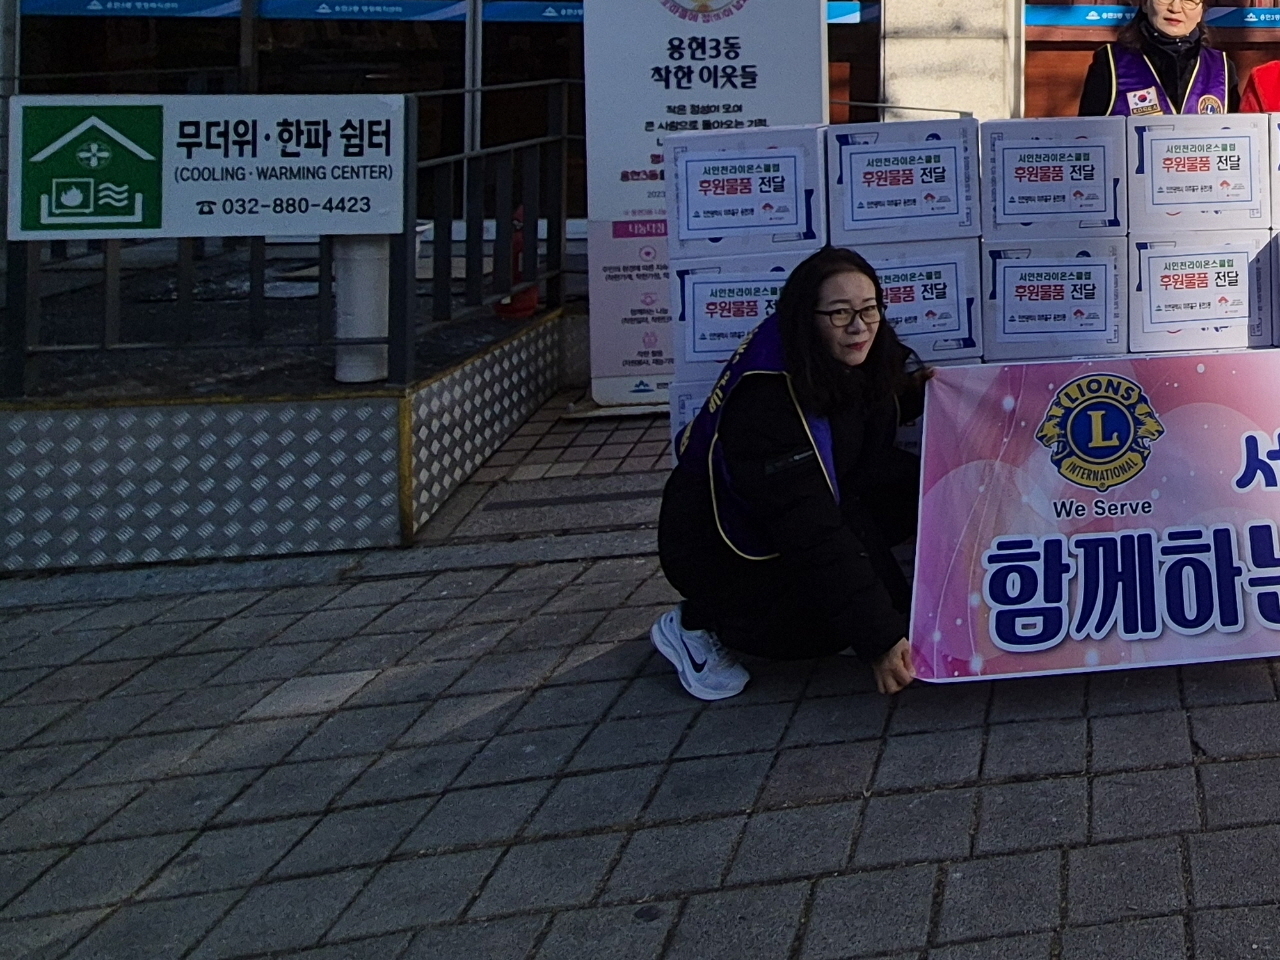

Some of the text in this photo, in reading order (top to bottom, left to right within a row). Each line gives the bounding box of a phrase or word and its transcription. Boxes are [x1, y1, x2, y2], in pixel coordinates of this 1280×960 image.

[667, 36, 741, 60] 용현3동
[651, 64, 758, 89] 착한 이웃들
[339, 118, 391, 157] 쉼터
[1166, 143, 1236, 153] 서인천라이온스클럽
[867, 154, 941, 167] 서인천라이온스클럽
[1019, 153, 1090, 163] 서인천라이온스클럽
[1162, 155, 1241, 173] 후원물품 전달
[331, 165, 393, 181] CENTER)
[703, 163, 780, 176] 서인천라이온스클럽
[863, 166, 946, 187] 후원물품 전달
[1015, 165, 1095, 183] 후원물품 전달
[698, 176, 785, 196] 후원물품 전달
[222, 196, 371, 215] 032-880-4423
[1164, 259, 1234, 271] 서인천라이온스클럽
[877, 270, 942, 285] 천라이온스클럽
[1019, 271, 1091, 282] 서인천라이온스클럽
[1160, 271, 1239, 291] 후원물품 전달
[921, 281, 948, 301] 전달
[1015, 284, 1095, 301] 후원물품 전달
[706, 300, 760, 319] 후원물품
[1063, 379, 1136, 404] LIONS
[1087, 410, 1120, 448] L
[1065, 457, 1139, 481] INTERNATIONAL
[1053, 499, 1152, 518] We Serve
